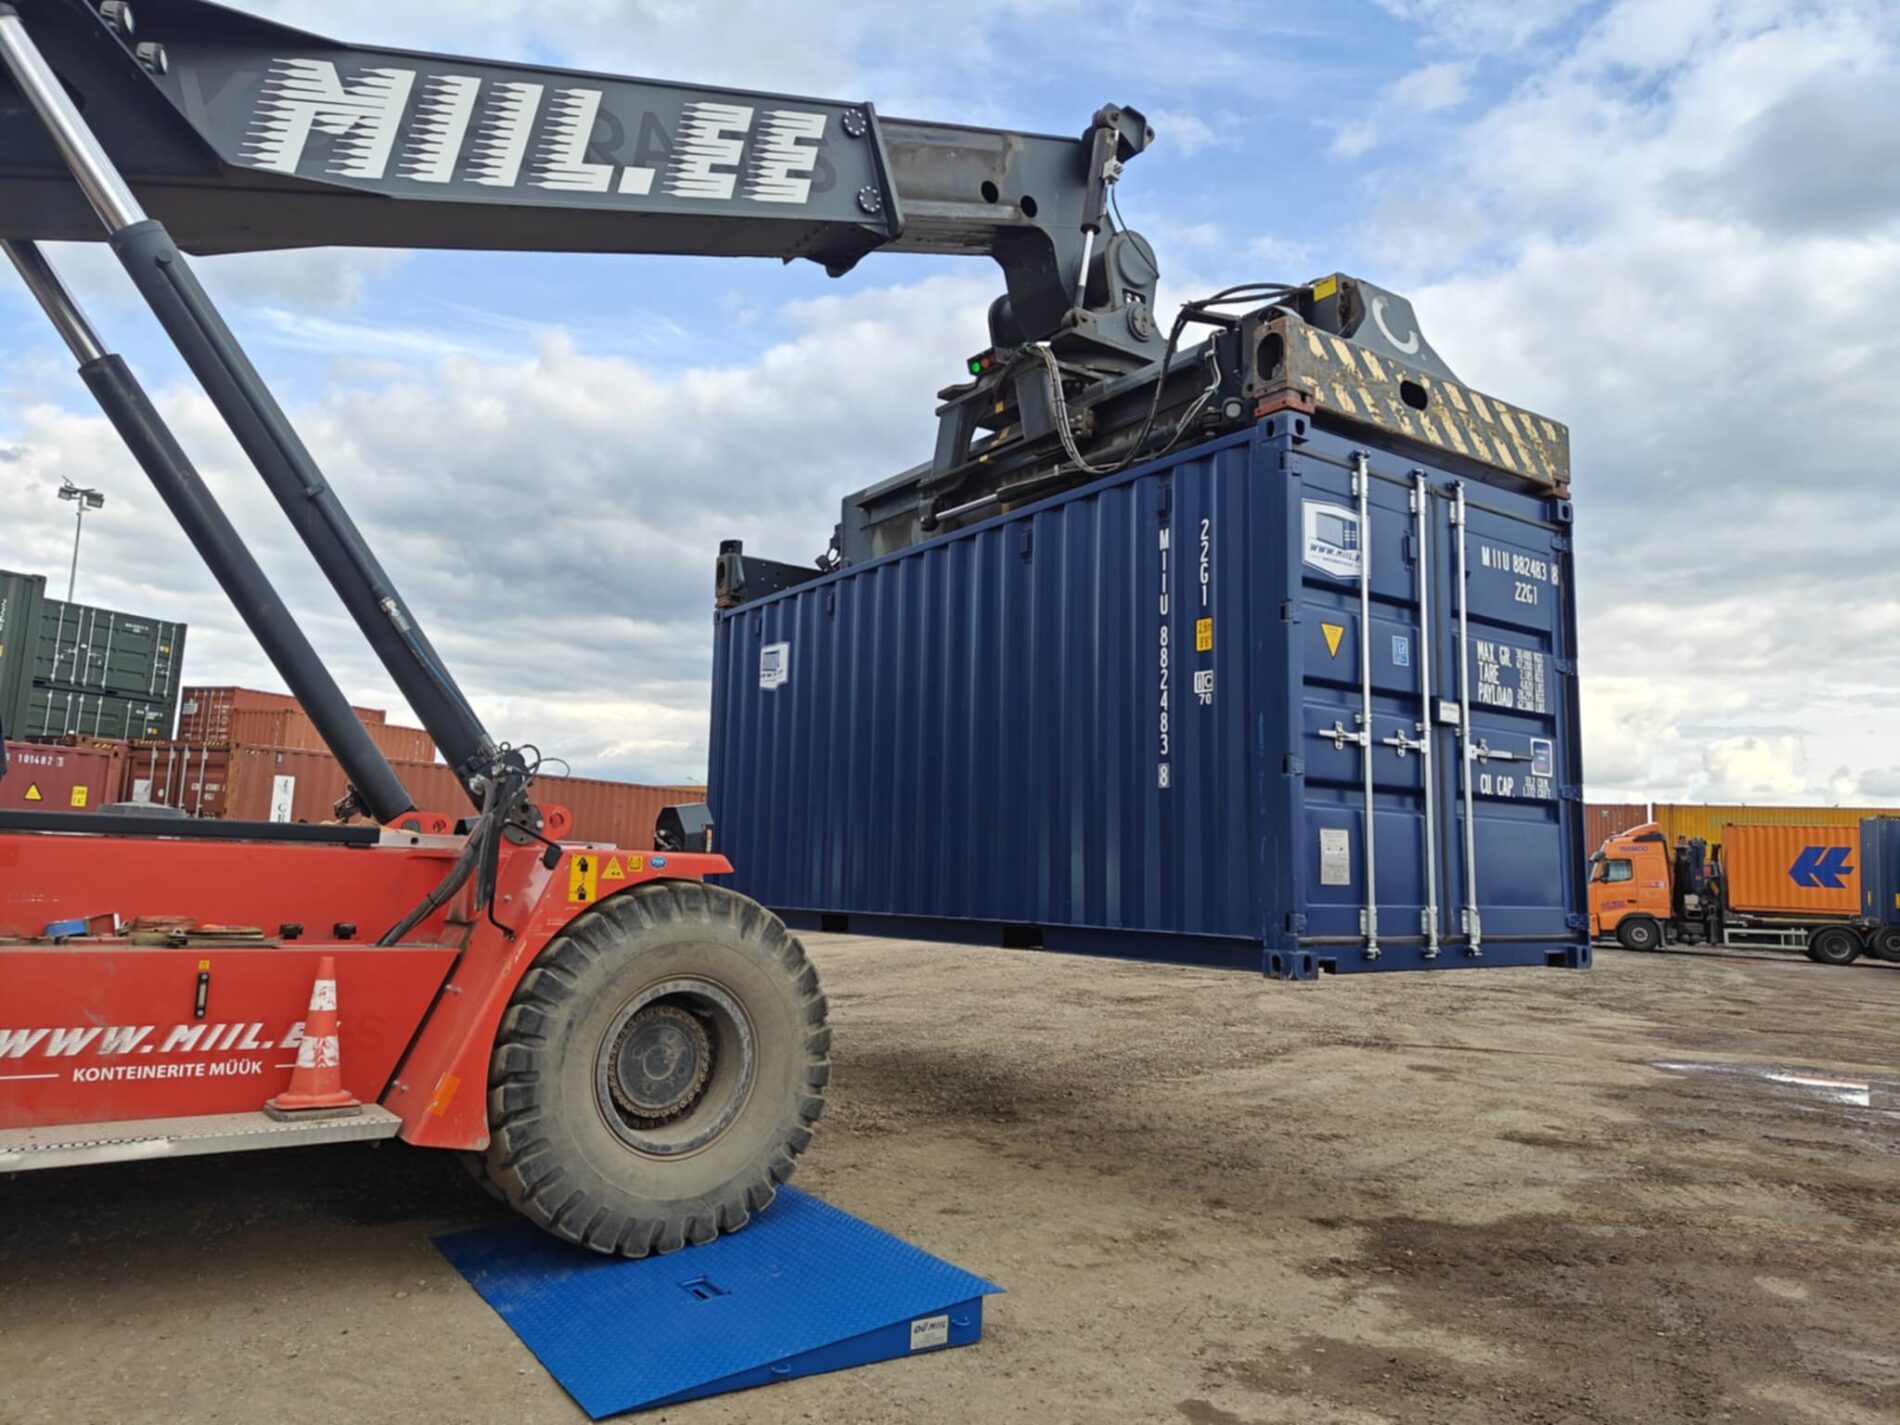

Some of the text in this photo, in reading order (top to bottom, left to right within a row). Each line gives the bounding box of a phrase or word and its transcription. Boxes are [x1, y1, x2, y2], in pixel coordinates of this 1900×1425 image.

[237, 58, 828, 204] MIIL.EE
[1200, 518, 1210, 607] 22G1
[1481, 545, 1510, 572] MIIU
[1512, 553, 1547, 581] 882483
[1514, 581, 1538, 605] 22G1
[1158, 527, 1170, 788] MIIU 882483 8
[1478, 661, 1500, 685] TARE
[1198, 693, 1212, 705] 70
[1478, 682, 1513, 708] PAYLOAD
[72, 1058, 263, 1083] KONTEINERITE MÜÜK
